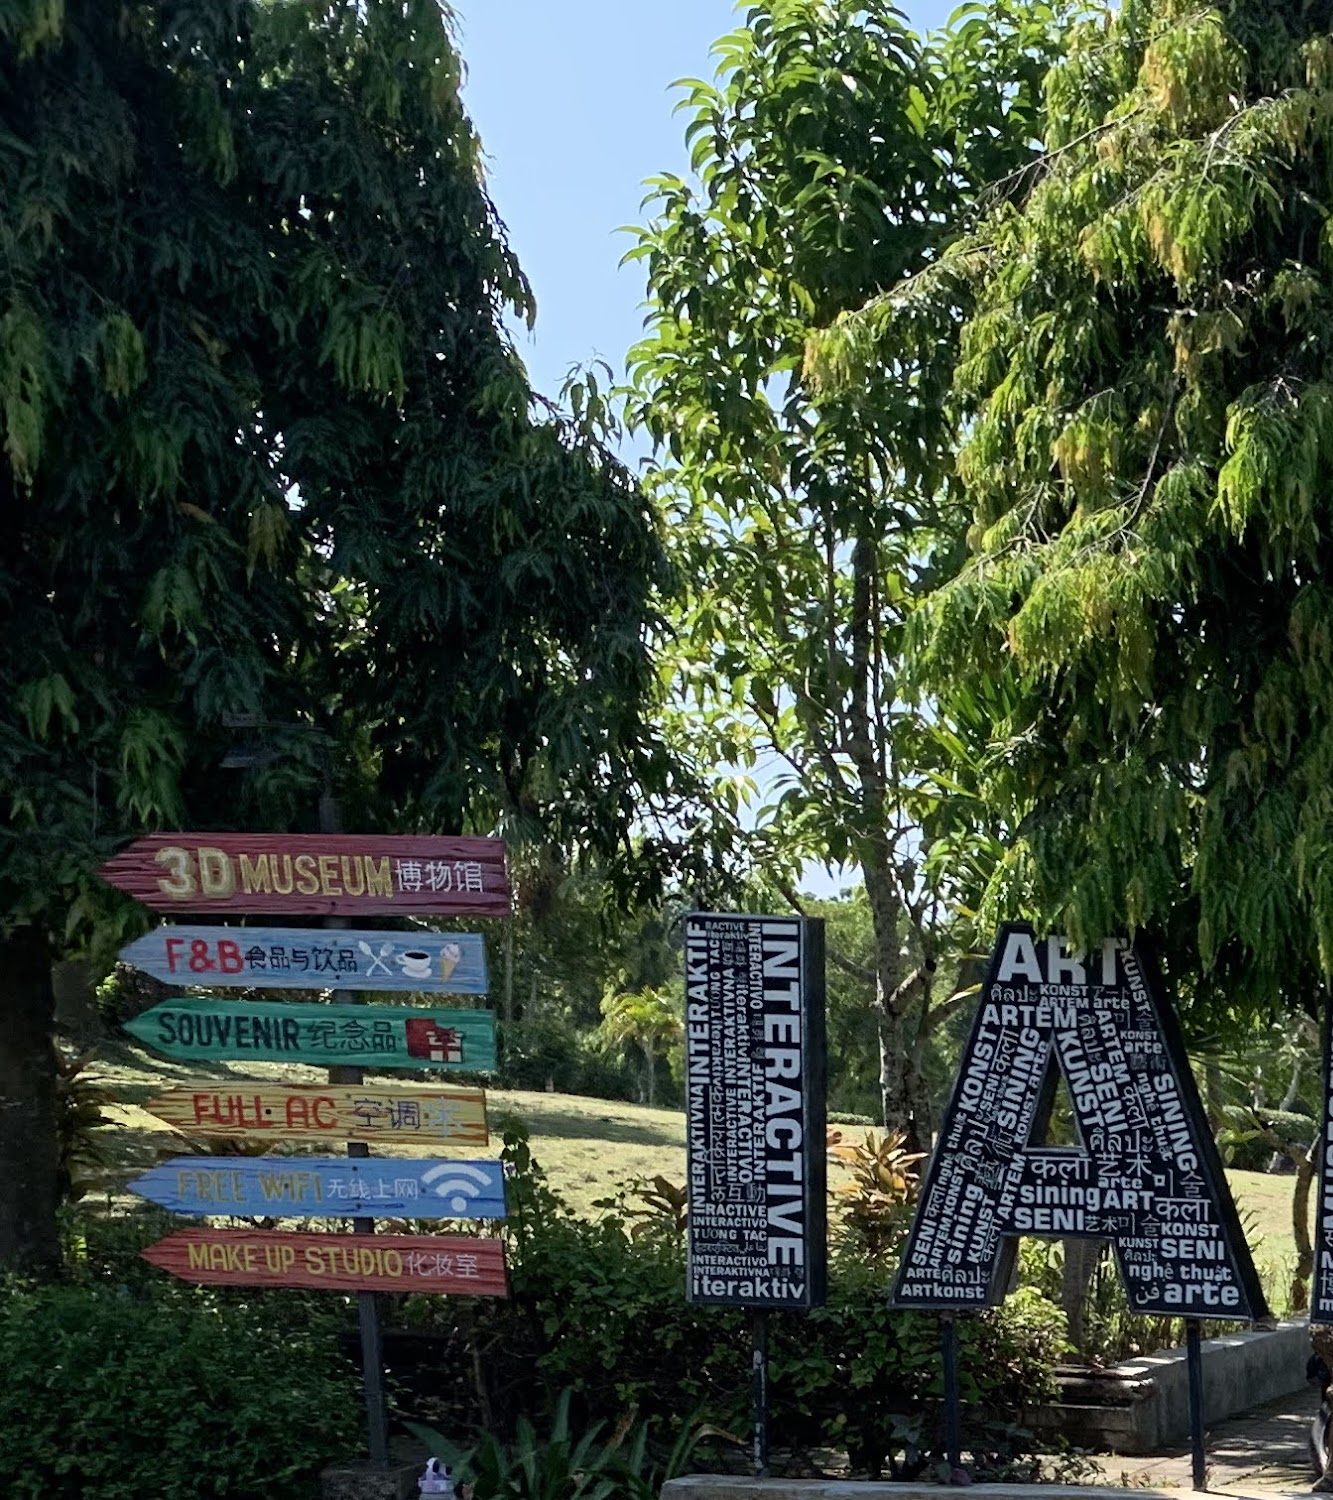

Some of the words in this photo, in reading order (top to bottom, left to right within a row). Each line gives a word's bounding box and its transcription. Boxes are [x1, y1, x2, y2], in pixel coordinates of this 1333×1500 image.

[155, 846, 236, 900] 3D
[240, 853, 394, 898] MUSEUM
[395, 859, 484, 894] 博物馆
[165, 938, 244, 975] F&B
[245, 945, 358, 973] 食品与饮品
[748, 922, 764, 1010] INTERACTIVO
[997, 932, 1128, 986] ART
[687, 921, 710, 1084] INTERAKTIF
[1039, 984, 1089, 997] KONST
[1039, 997, 1090, 1010] ARTEM
[1093, 998, 1131, 1010] arte
[158, 1012, 300, 1051] SOUVENIR
[722, 967, 737, 1084] INTERAKTIVNA
[981, 1003, 1078, 1029] ARTEM
[1119, 1030, 1158, 1040] KONST
[1095, 1009, 1132, 1085] ARTEM
[1123, 1040, 1163, 1054] arte
[958, 1026, 998, 1113] KONST
[997, 1028, 1041, 1130] SINING
[1056, 1030, 1106, 1128] KUNST
[193, 1094, 273, 1129] FULL
[285, 1096, 338, 1129] AC
[353, 1098, 421, 1131] 空调
[761, 922, 804, 1266] INTERACTIVE
[1090, 1062, 1130, 1134] SENI
[725, 1087, 738, 1182] INTERACTIVE
[752, 1062, 766, 1181] INTERAKTIF
[1013, 1091, 1036, 1145] KONST
[1153, 1073, 1198, 1172] SINING
[689, 1084, 706, 1214] INTERAKTIVNA
[177, 1170, 246, 1203] FREE
[259, 1169, 322, 1203] WIFI
[327, 1178, 418, 1201] 无线上网
[942, 1166, 966, 1217] KONST
[997, 1153, 1027, 1220] ARTEM
[1020, 1178, 1100, 1212] sining
[1097, 1176, 1143, 1190] arte
[1103, 1190, 1155, 1211] ART
[692, 1216, 768, 1229] INTERACTIVO
[705, 1203, 767, 1218] RACTIVE
[947, 1183, 984, 1265] sining
[966, 1193, 996, 1264] KUNST
[1014, 1206, 1085, 1232] SENI
[911, 1218, 938, 1266] SENI
[929, 1215, 954, 1269] ARTEM
[1118, 1236, 1160, 1249] KUNST
[1161, 1222, 1220, 1238] KONST
[186, 1243, 258, 1274] MAKE
[264, 1245, 295, 1273] UP
[305, 1246, 403, 1278] STUDIO
[408, 1252, 480, 1279] 化妆室
[692, 1254, 768, 1267] INTERACTIVO
[1160, 1238, 1225, 1261] SENI
[693, 1265, 771, 1278] INTERAKTIVNA
[693, 1275, 805, 1299] iteraktiv
[1163, 1282, 1240, 1306] arte
